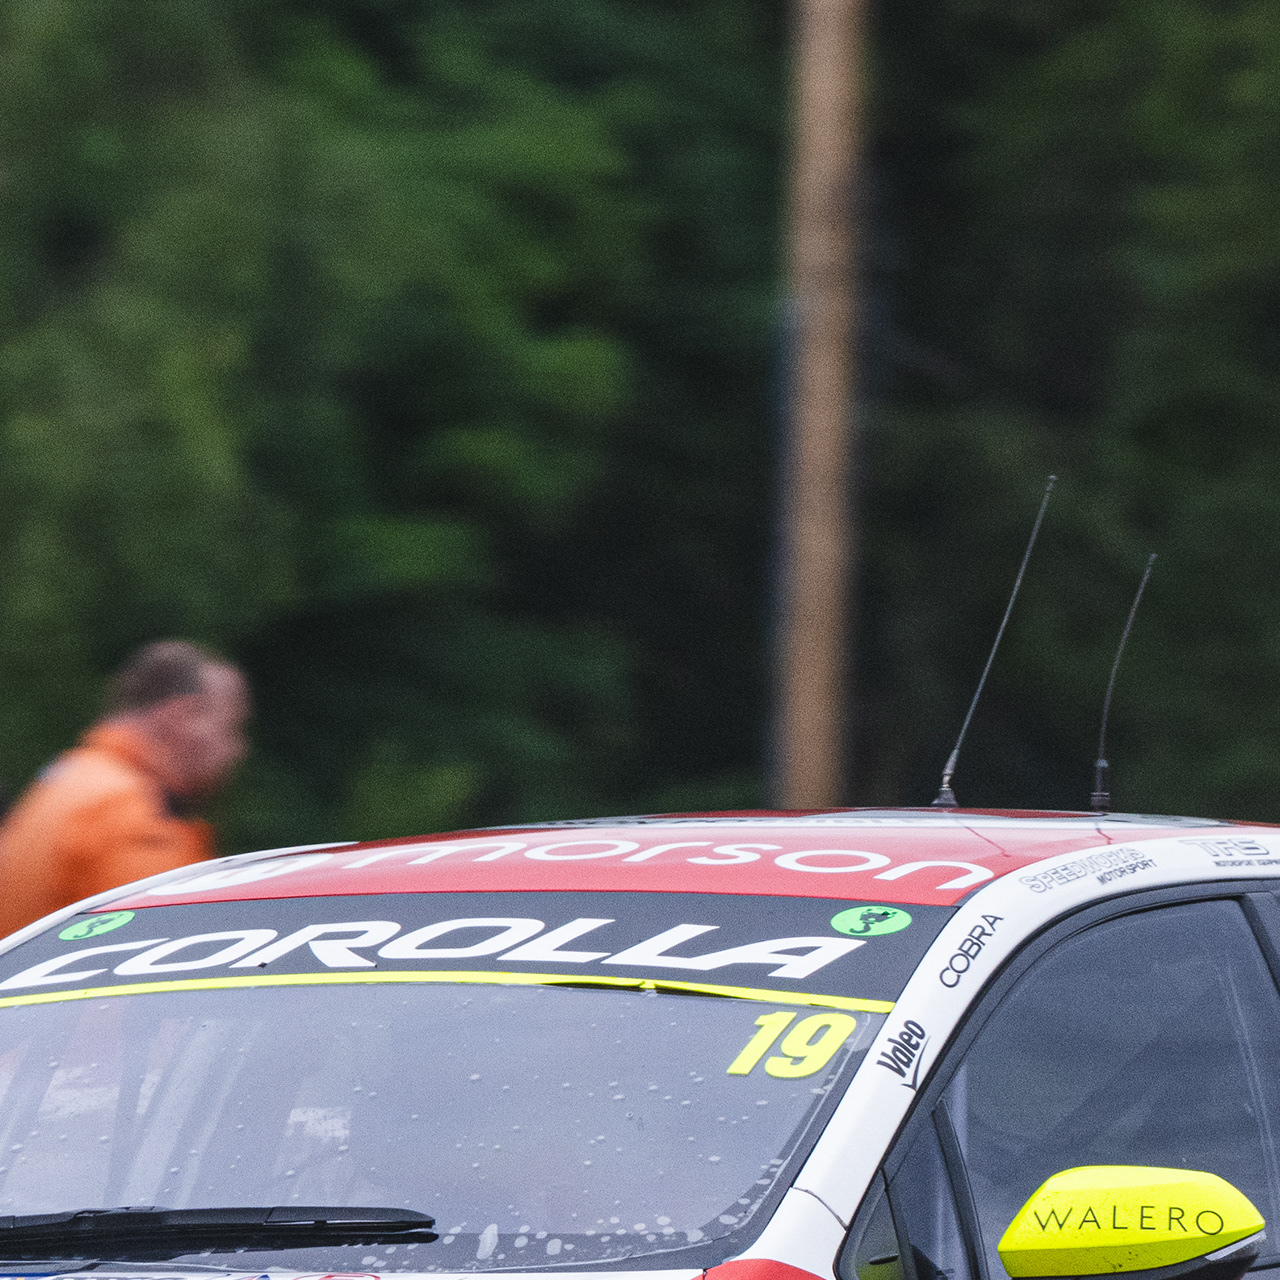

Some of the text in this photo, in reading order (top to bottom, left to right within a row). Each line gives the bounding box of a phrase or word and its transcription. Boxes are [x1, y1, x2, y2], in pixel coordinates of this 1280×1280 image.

[1018, 847, 1145, 893] SPEEDWORKS
[1096, 859, 1157, 885] MOTORSPORT
[939, 914, 1004, 988] COBRA
[726, 1011, 856, 1078] 19
[876, 1020, 926, 1078] Valeo
[1034, 1205, 1224, 1236] WALERO
